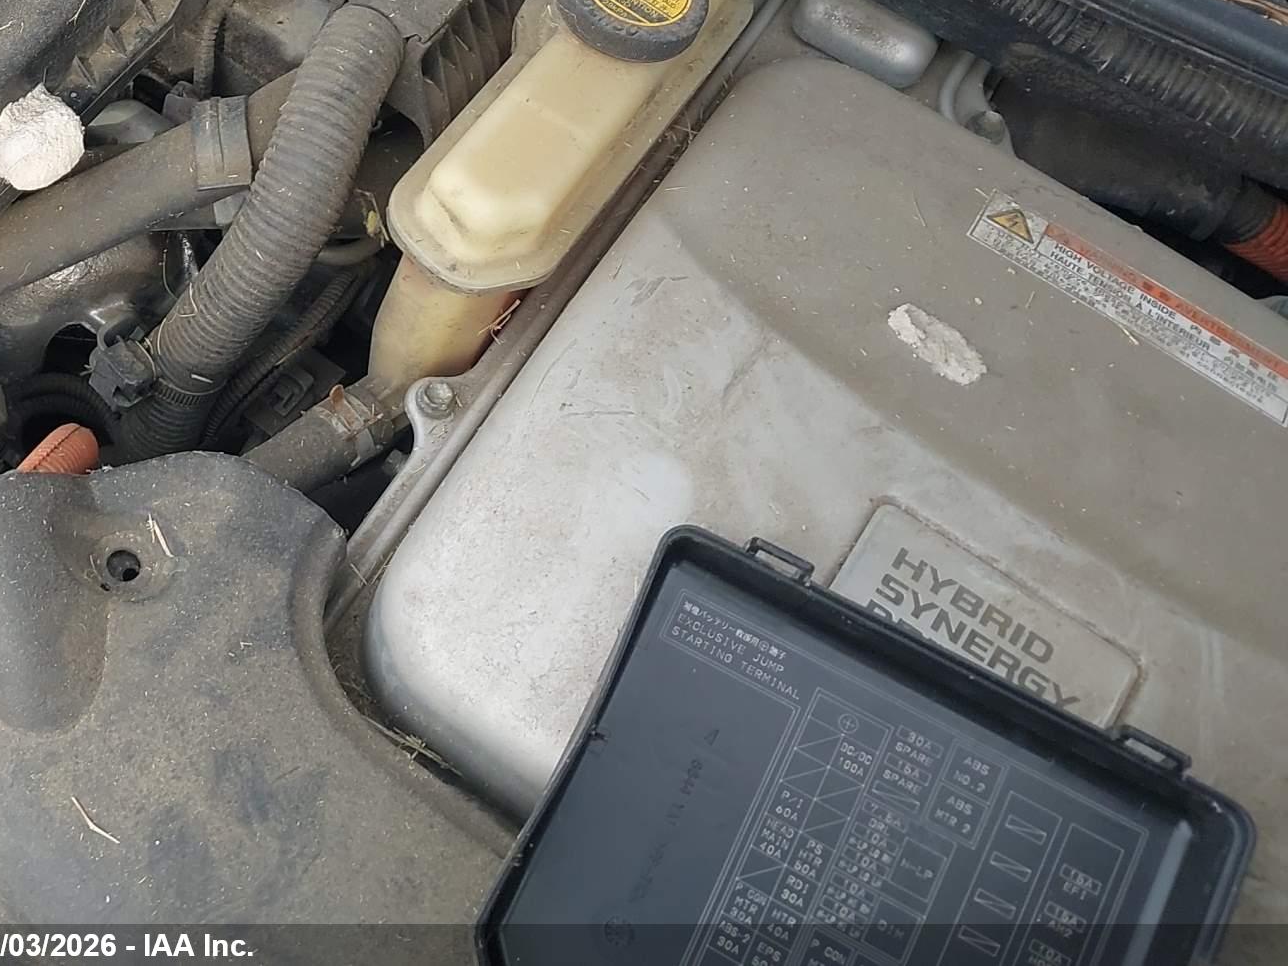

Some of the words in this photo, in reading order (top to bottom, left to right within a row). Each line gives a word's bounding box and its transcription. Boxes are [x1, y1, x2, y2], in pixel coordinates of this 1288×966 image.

[1050, 251, 1083, 274] HAUTE
[1088, 272, 1132, 303] TENSION
[1054, 243, 1082, 263] HIGH
[1087, 261, 1136, 295] VOLTAGE
[1139, 293, 1177, 320] INSIDE
[891, 547, 1054, 664] HYBRID
[676, 612, 746, 656] EXCLUSIVE
[752, 650, 785, 674] JUMP
[875, 573, 1081, 709] SYNERGY
[671, 624, 733, 664] STARTING
[741, 660, 800, 700] TERMINAL
[907, 732, 932, 751] 30A
[840, 742, 872, 765] DC/DC
[895, 741, 934, 767] SPARE
[839, 756, 864, 777] 100A
[897, 759, 921, 780] 15A
[963, 756, 990, 776] ABS
[882, 769, 924, 796] SPARE
[775, 805, 798, 822] 60A
[946, 796, 973, 816] ABS
[765, 817, 795, 839] HEAD
[867, 817, 890, 837] DRL
[759, 841, 782, 859] 40A
[761, 828, 790, 851] MAIN
[806, 840, 824, 856] PS
[735, 881, 745, 892] P
[746, 889, 769, 907] CON
[780, 888, 804, 908] 30A
[730, 906, 753, 925] 30A
[734, 896, 758, 915] MTR
[772, 908, 797, 928] HTR
[767, 923, 790, 941] 40A
[717, 935, 740, 954] 30A
[757, 941, 782, 963] EPS
